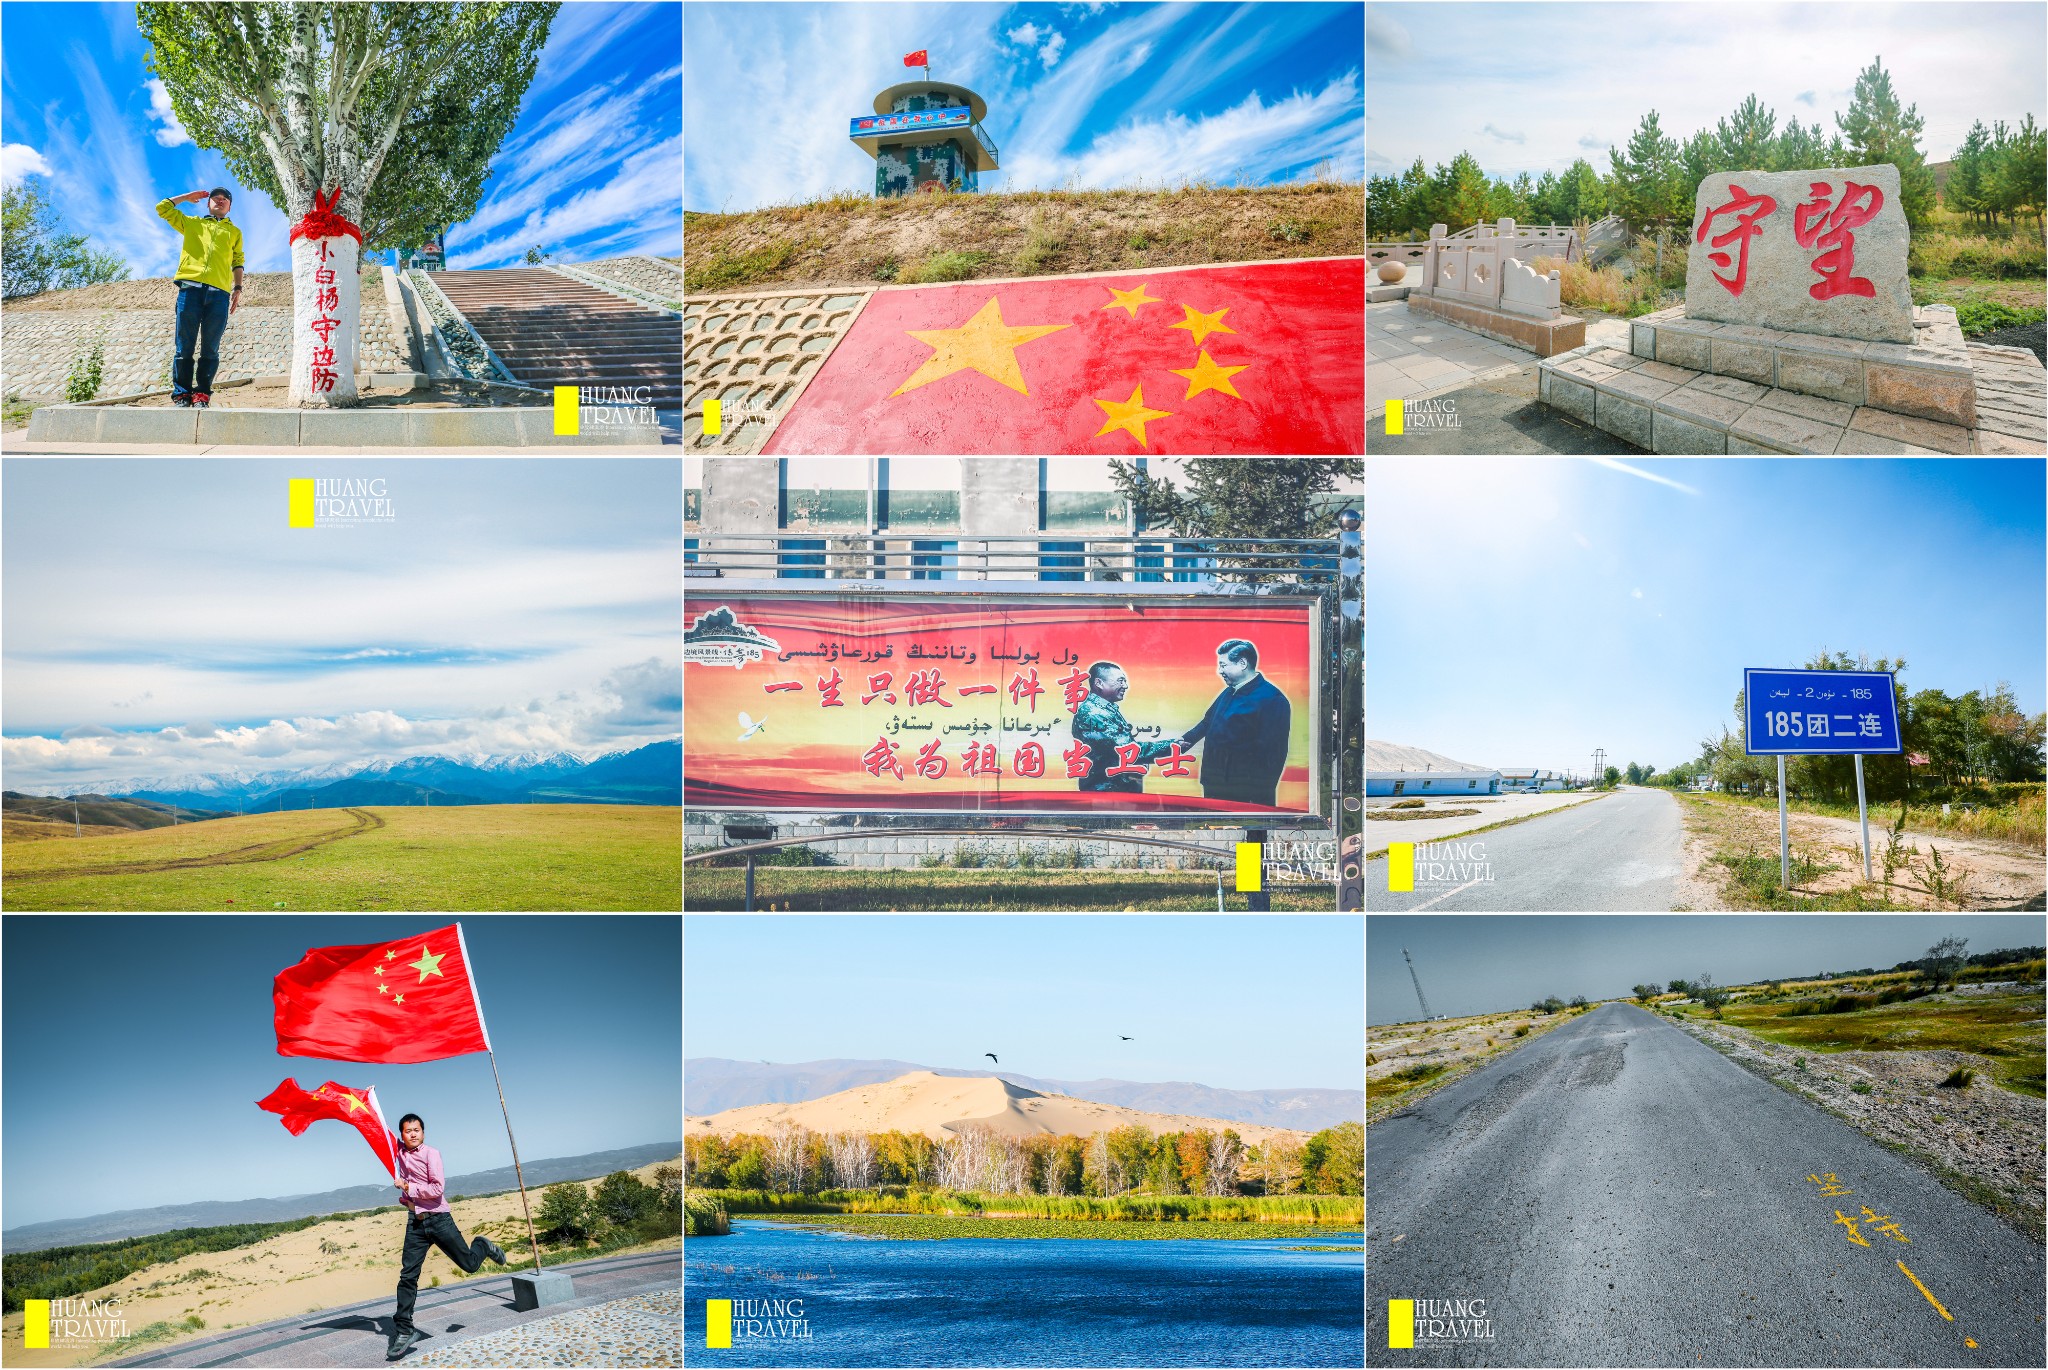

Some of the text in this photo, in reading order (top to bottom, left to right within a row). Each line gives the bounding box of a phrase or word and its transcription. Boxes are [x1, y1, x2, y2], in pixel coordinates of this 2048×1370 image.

[1696, 181, 1885, 301] 守望
[310, 240, 342, 394] 小白杨守边防
[763, 666, 1092, 714] 一生只做一件事
[1850, 688, 1873, 699] 185
[1765, 711, 1883, 738] 185团二连
[862, 735, 1197, 780] 我为祖国当卫士
